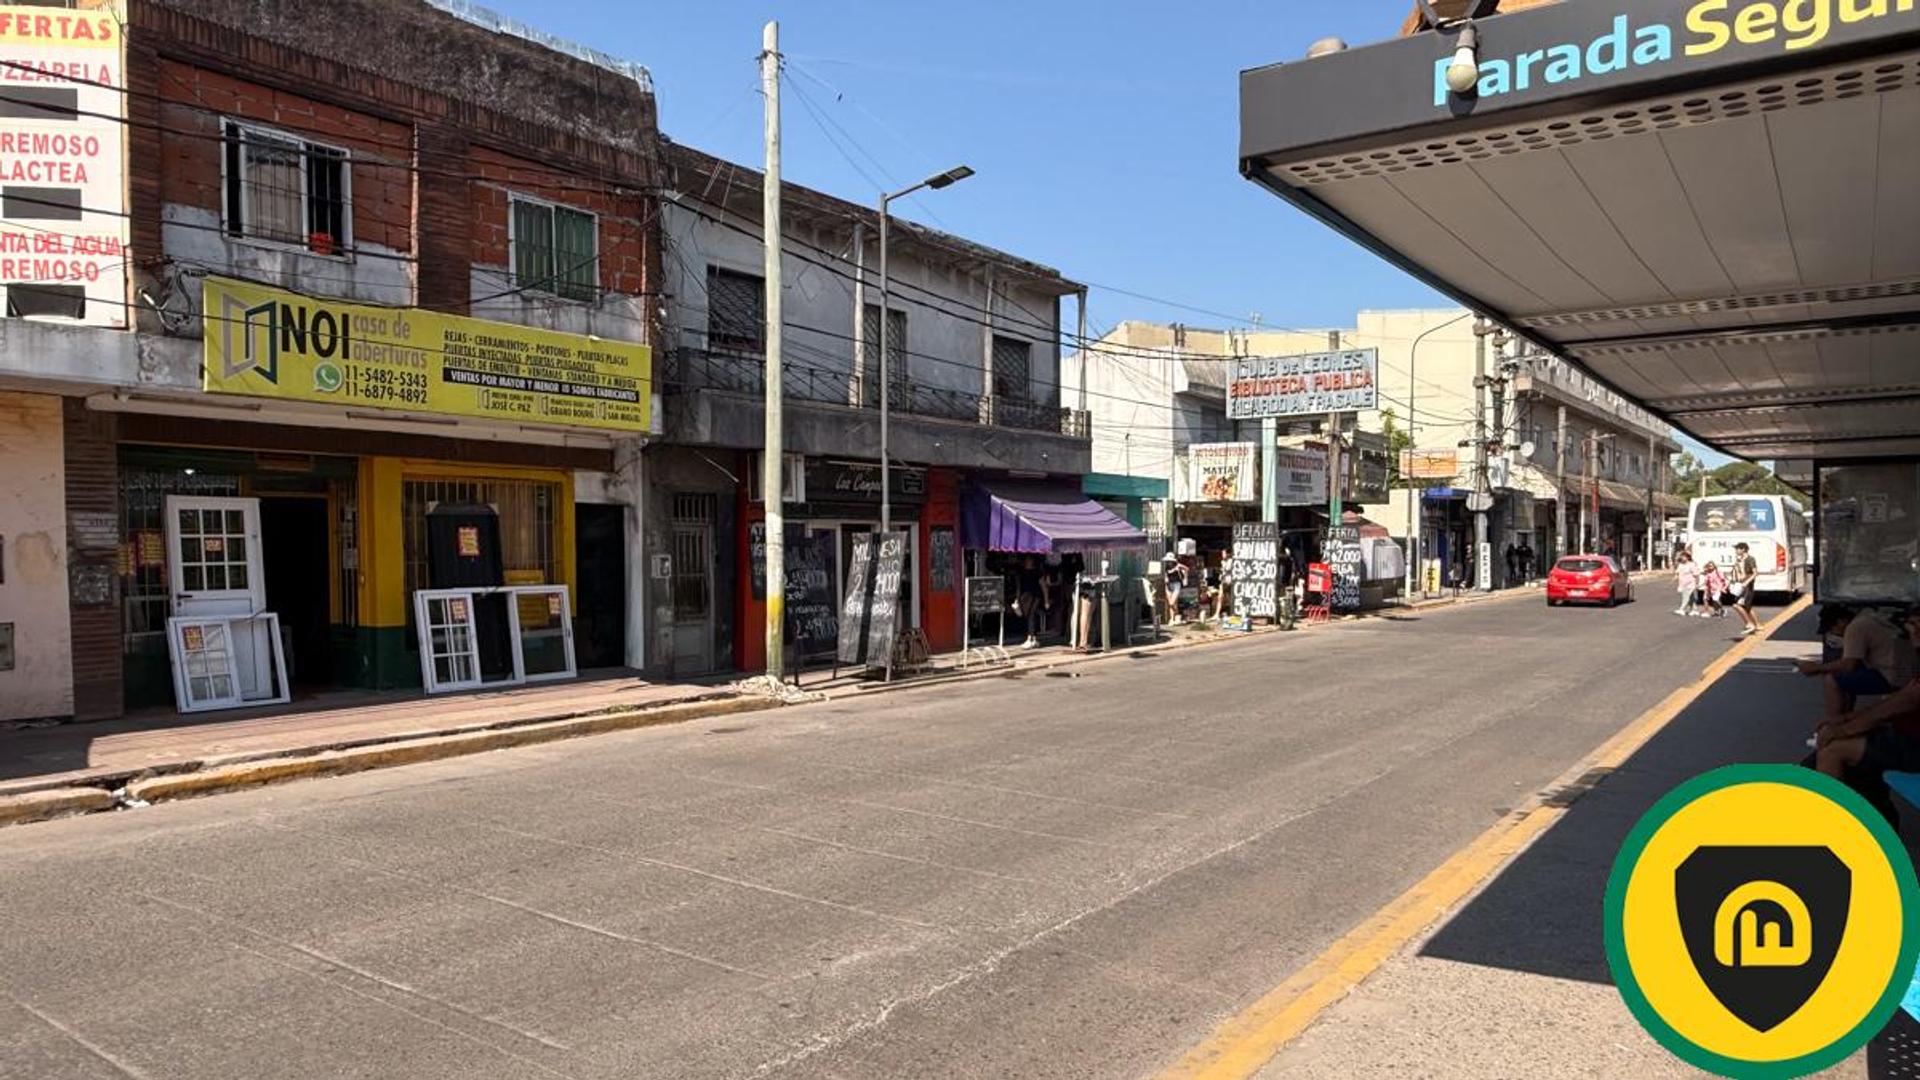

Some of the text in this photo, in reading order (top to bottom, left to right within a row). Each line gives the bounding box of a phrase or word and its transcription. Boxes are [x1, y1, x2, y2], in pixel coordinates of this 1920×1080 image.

[281, 303, 411, 360] NOI casa de
[353, 334, 428, 369] aberturas
[1230, 376, 1308, 399] BIBLIOTECA
